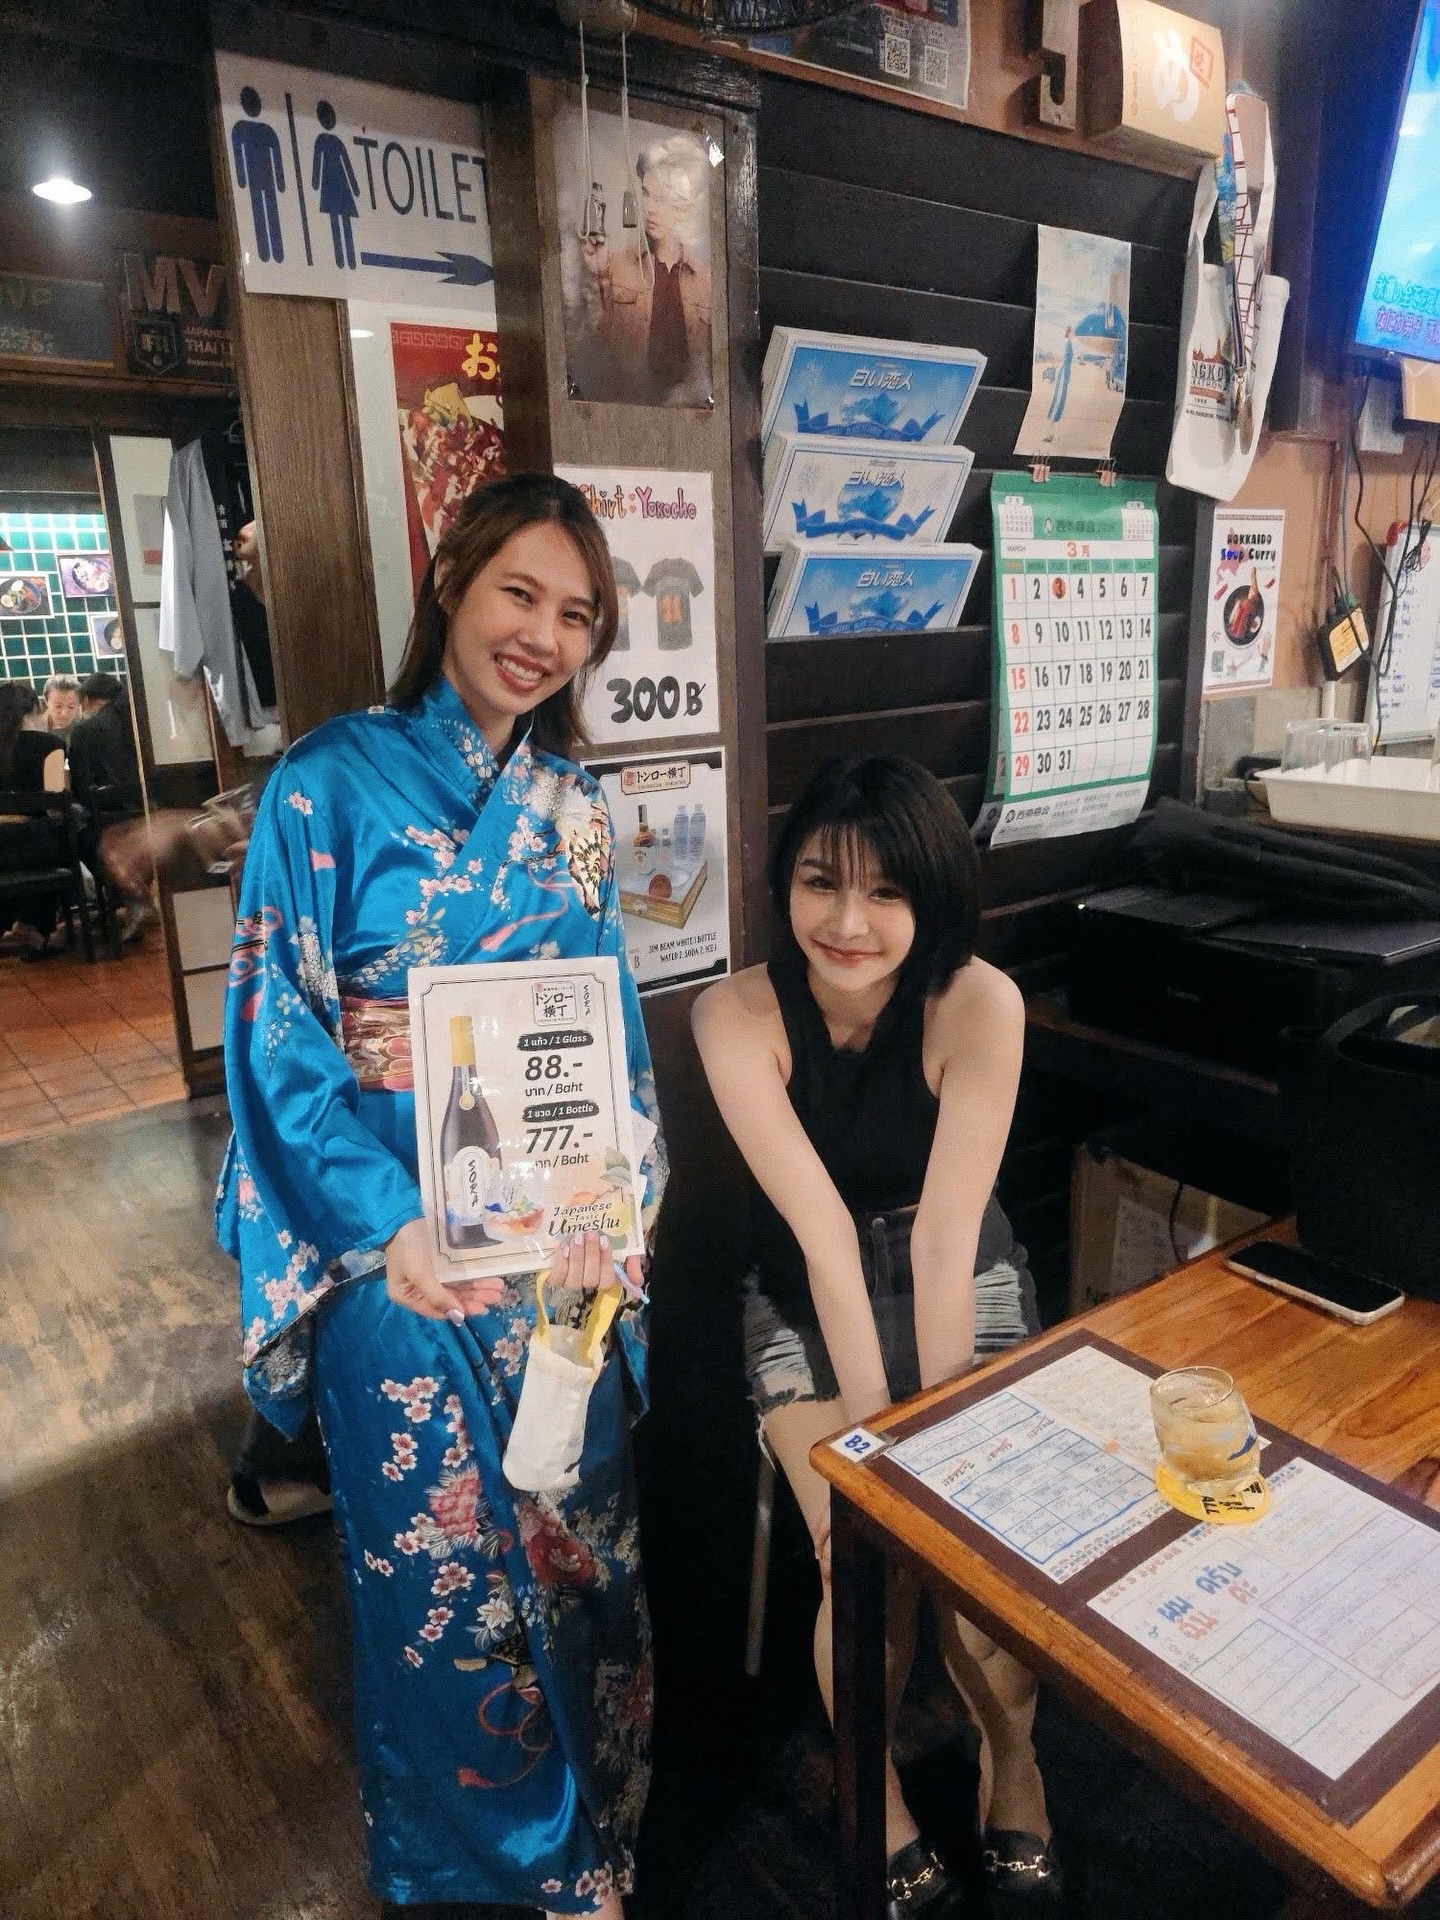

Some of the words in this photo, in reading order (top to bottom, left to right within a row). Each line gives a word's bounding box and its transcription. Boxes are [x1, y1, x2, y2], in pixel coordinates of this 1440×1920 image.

[850, 366, 913, 391] 白い恋人
[848, 470, 905, 488] 白い恋人
[1227, 533, 1272, 545] HOKKAIDO
[1248, 547, 1276, 562] Curry
[856, 568, 915, 588] 白い恋人
[1011, 577, 1017, 600] 1
[1033, 577, 1041, 600] 2
[1055, 577, 1063, 599] 3
[1077, 577, 1084, 599] 4
[1099, 577, 1106, 598] 5
[1120, 577, 1128, 598] 6
[1142, 577, 1149, 597] 7
[1011, 623, 1020, 645] 8
[1035, 622, 1043, 643] 9
[1055, 621, 1070, 642] 10
[1077, 620, 1091, 641] 11
[1099, 619, 1113, 640] 12
[1120, 619, 1133, 640] 13
[1140, 618, 1151, 638] 14
[1011, 667, 1026, 690] 15
[1035, 666, 1049, 687] 16
[1058, 665, 1071, 686] 17
[1080, 663, 1093, 684] 18
[1101, 662, 1112, 682] 19
[1119, 660, 1131, 680] 20
[1138, 659, 1149, 679] 21
[607, 675, 680, 723] 300
[1014, 711, 1029, 734] 22
[1037, 709, 1051, 731] 23
[1058, 707, 1073, 729] 24
[1079, 705, 1093, 727] 25
[1099, 704, 1112, 724] 26
[1118, 702, 1131, 722] 27
[1137, 700, 1150, 720] 28
[1015, 754, 1030, 777] 29
[1037, 752, 1052, 774] 30
[1058, 749, 1071, 771] 31
[637, 766, 686, 783] トンロー横丁
[660, 940, 675, 951] BEAM
[675, 936, 693, 948] WHITE
[697, 932, 717, 944] BOTTLE
[660, 953, 678, 962] WATER
[535, 993, 573, 1006] トンロー
[543, 1004, 567, 1018] 横丁
[562, 1034, 587, 1044] Glass
[525, 1054, 582, 1081] 88.-
[555, 1082, 583, 1094] Baht
[566, 1104, 594, 1115] Bottle
[526, 1124, 593, 1154] 777.-
[561, 1153, 589, 1166] Baht
[468, 1160, 478, 1207] SORA
[553, 1201, 612, 1216] Japanese
[549, 1212, 620, 1237] Umeshu
[844, 1434, 871, 1454] B2
